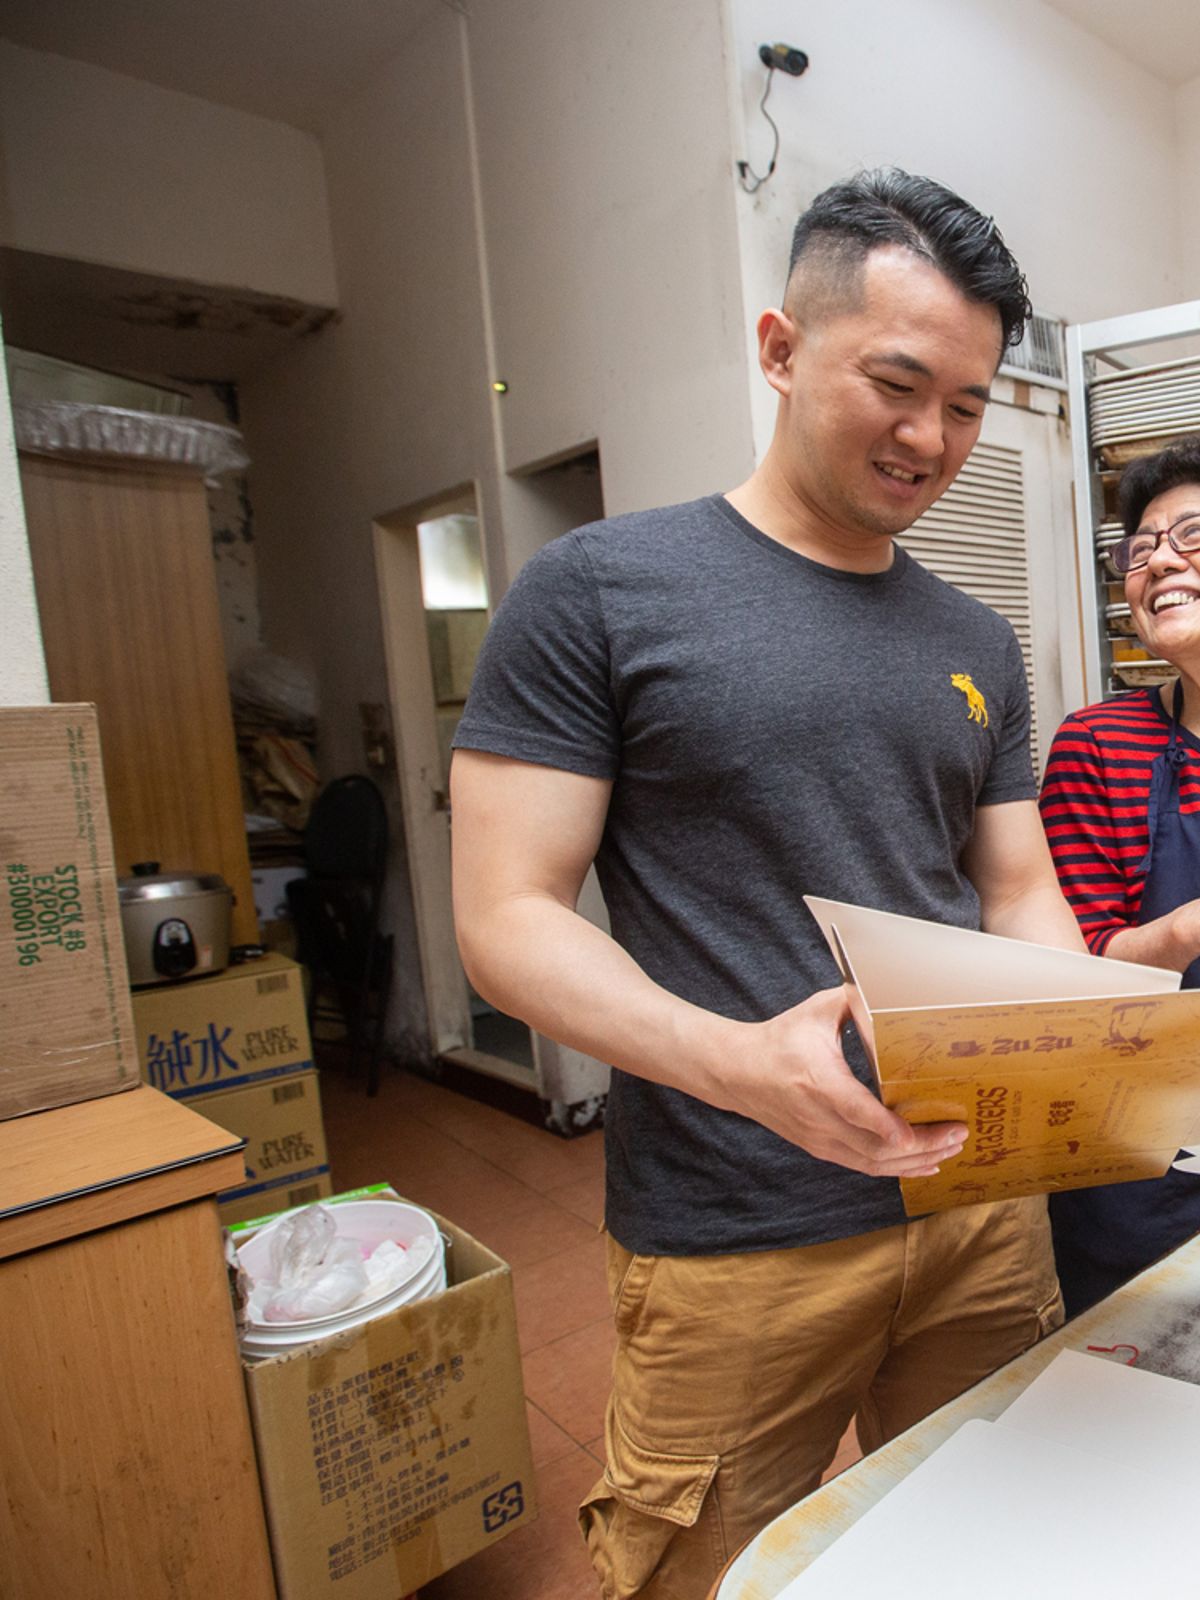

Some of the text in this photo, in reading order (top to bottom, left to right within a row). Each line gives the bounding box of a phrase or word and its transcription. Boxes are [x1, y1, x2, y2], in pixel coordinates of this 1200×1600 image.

[55, 864, 84, 925] STOCK
[7, 863, 41, 967] #30000196
[33, 875, 63, 947] EXPORT
[64, 929, 87, 951] #8
[245, 1025, 292, 1044] PURE
[947, 1035, 1074, 1058] 吃吃看
[147, 1022, 239, 1091] 純水
[241, 1036, 299, 1061] WATER
[262, 1132, 306, 1152] PURE
[258, 1143, 315, 1169] WATER
